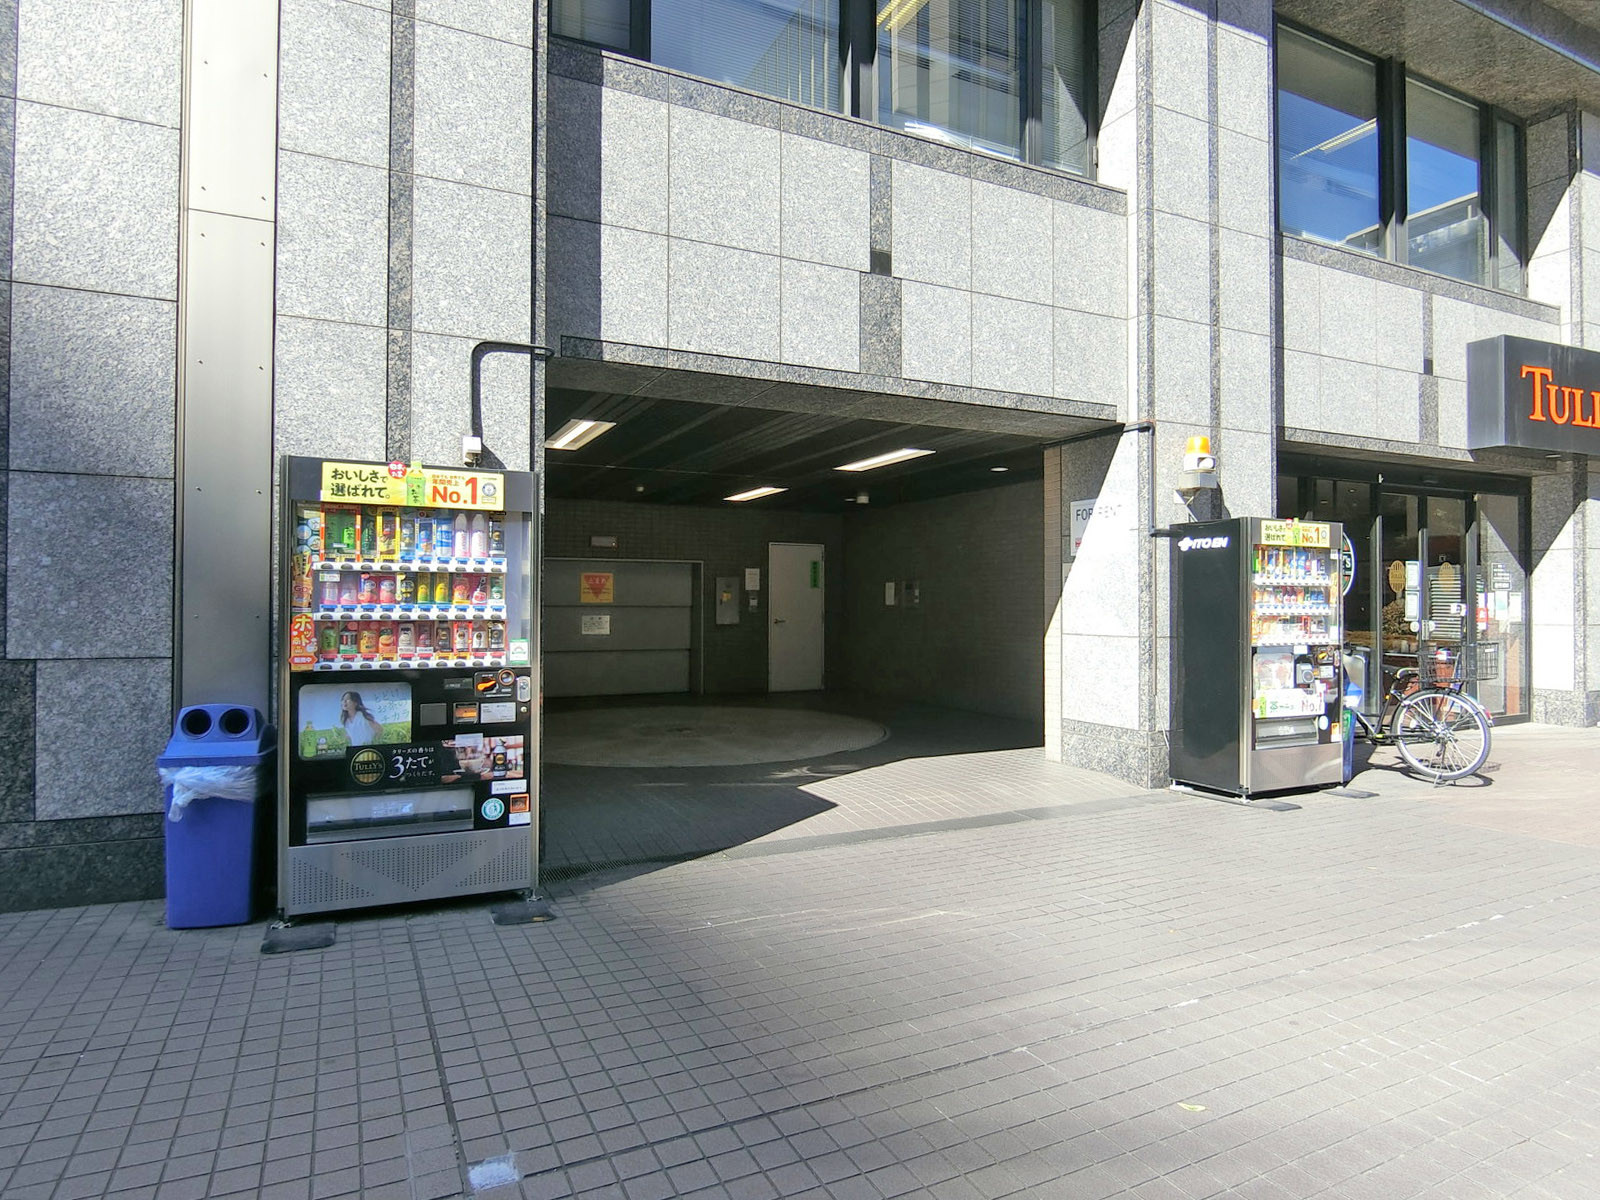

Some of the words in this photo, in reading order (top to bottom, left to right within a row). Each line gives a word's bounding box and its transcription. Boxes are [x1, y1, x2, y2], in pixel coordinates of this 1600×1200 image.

[331, 468, 388, 483] おいしさで
[331, 483, 390, 499] 選ばれて。
[433, 477, 477, 504] No.1
[1302, 527, 1320, 544] No.1
